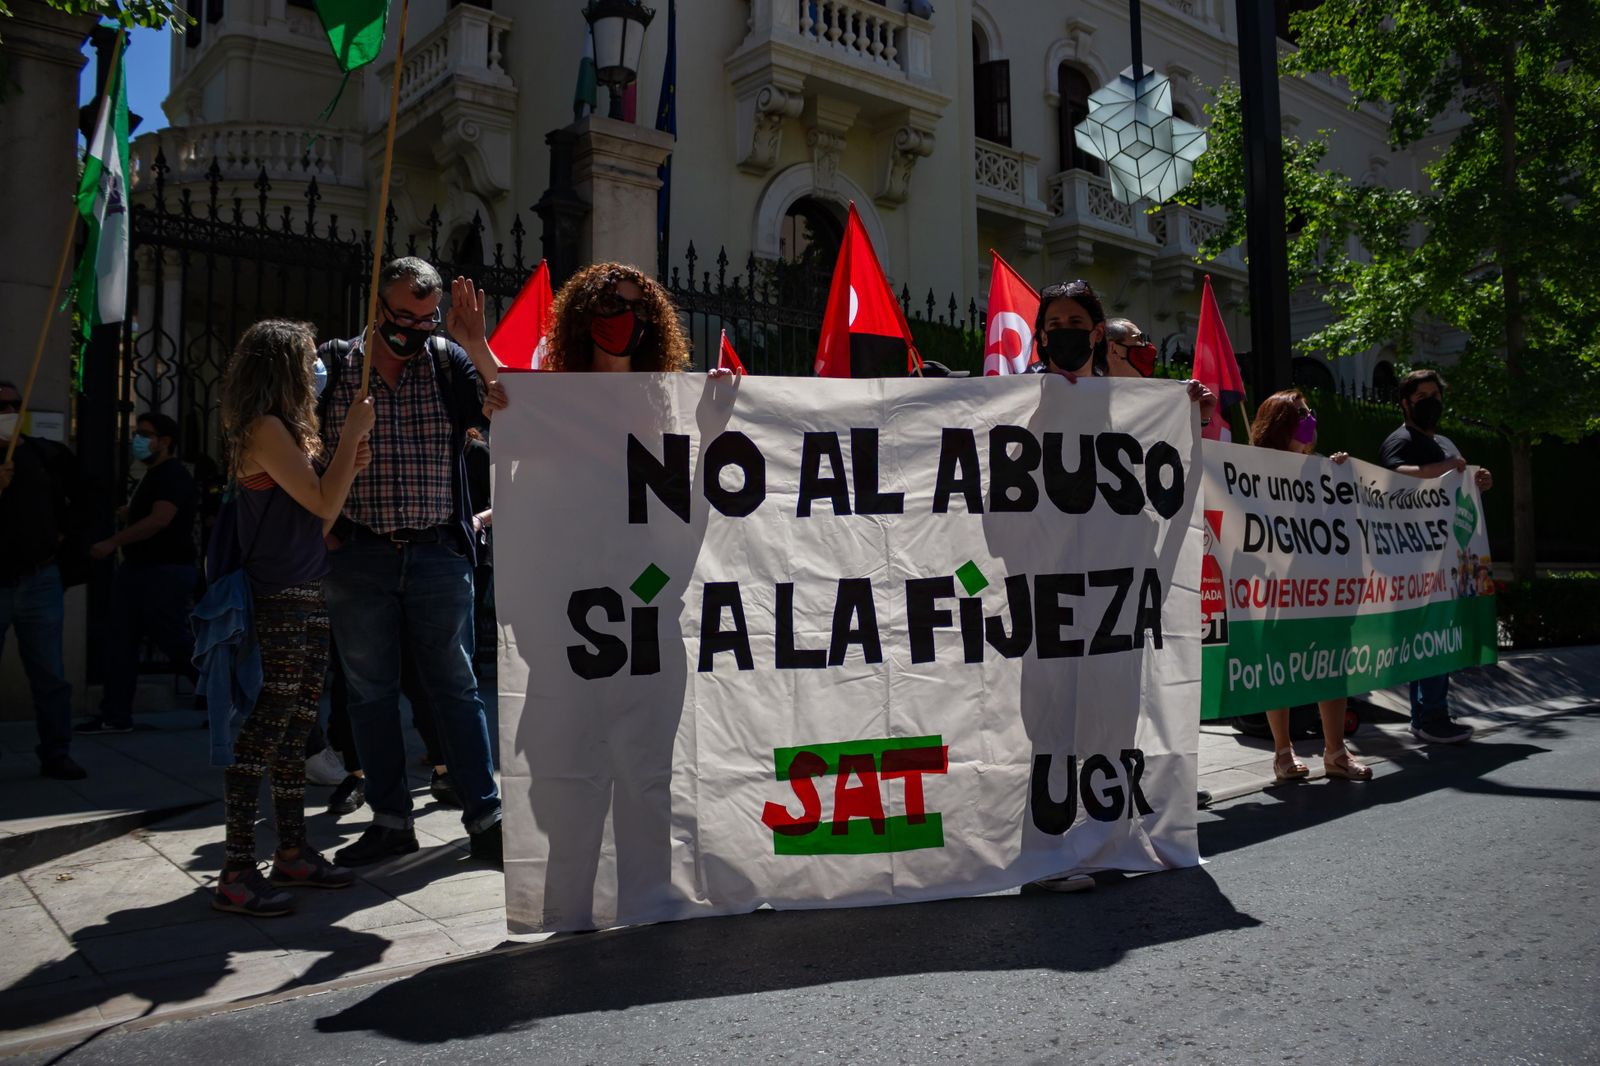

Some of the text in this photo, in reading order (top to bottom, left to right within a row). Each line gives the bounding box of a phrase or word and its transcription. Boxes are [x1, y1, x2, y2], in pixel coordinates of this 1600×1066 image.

[627, 424, 1186, 524] NO AL ABUSO
[1223, 461, 1261, 498] Por
[1267, 476, 1315, 504] unos
[1243, 512, 1448, 555] DIGNOS Y ESTABLES
[697, 581, 755, 673] A
[774, 577, 884, 670] LA
[1229, 578, 1330, 609] ¡QUIENES
[1334, 569, 1387, 606] ESTÁN
[1389, 575, 1405, 602] SE
[1229, 619, 1463, 692] Por lo PÚBLICO, por lo COMÚN
[761, 745, 949, 837] SAT
[1030, 748, 1154, 836] UGR
